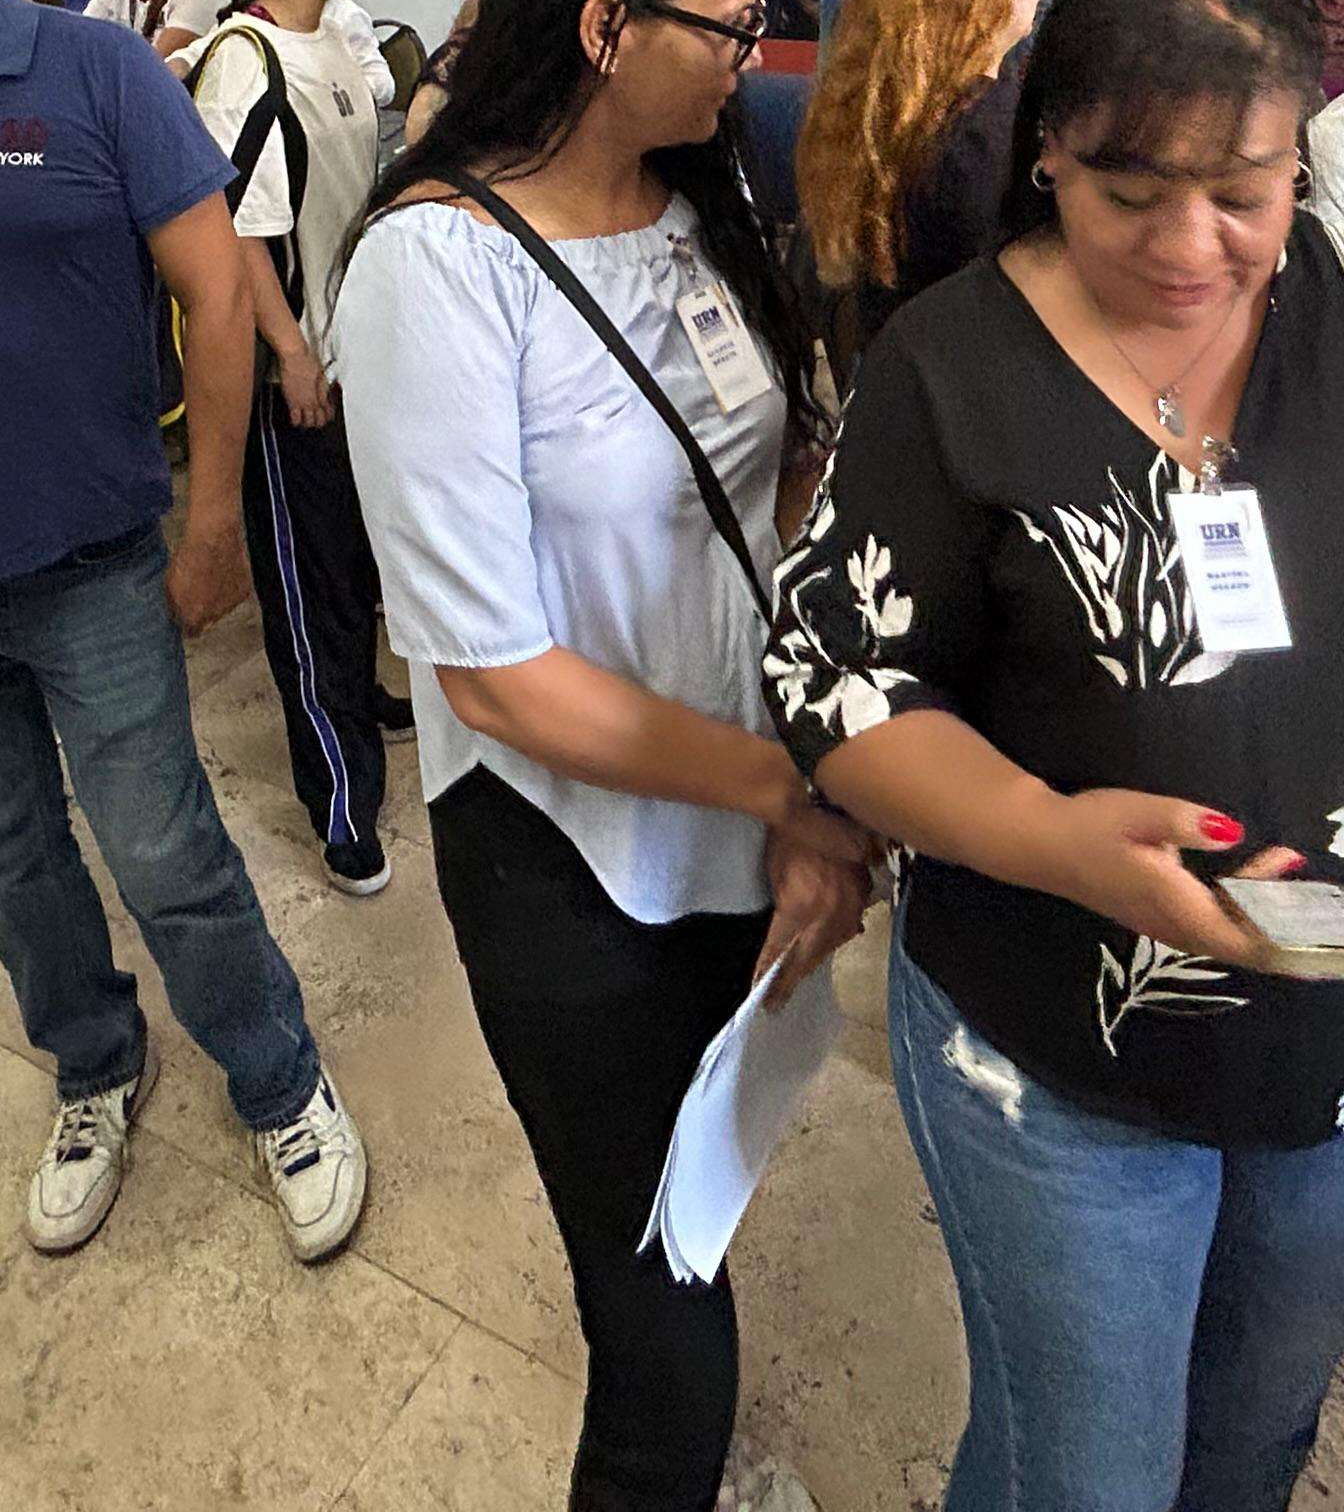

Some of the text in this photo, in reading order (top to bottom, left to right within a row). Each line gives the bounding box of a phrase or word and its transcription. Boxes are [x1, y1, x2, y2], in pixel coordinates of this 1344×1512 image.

[0, 151, 44, 166] YORK
[692, 306, 720, 328] URN
[1200, 522, 1240, 540] URN
